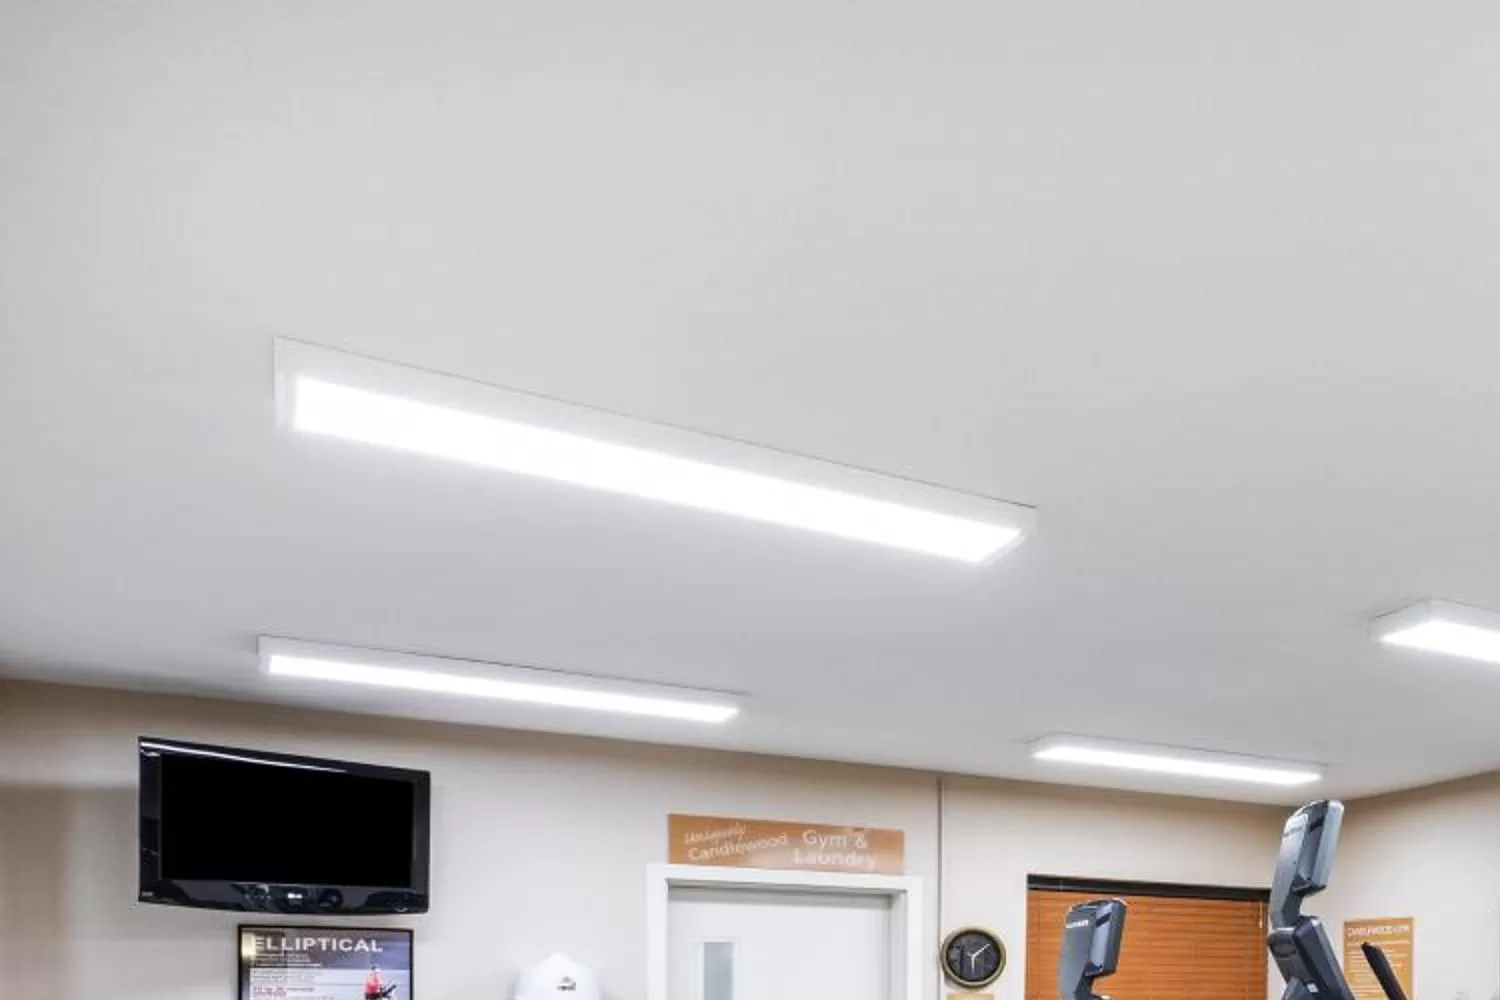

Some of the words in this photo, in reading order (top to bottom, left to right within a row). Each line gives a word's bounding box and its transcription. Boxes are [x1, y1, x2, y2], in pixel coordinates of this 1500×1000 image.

[687, 832, 789, 862] Candlewood
[802, 829, 848, 853] Gym
[854, 832, 869, 850] &
[792, 847, 877, 871] Laundry
[254, 936, 383, 953] ELLIPTICAL
